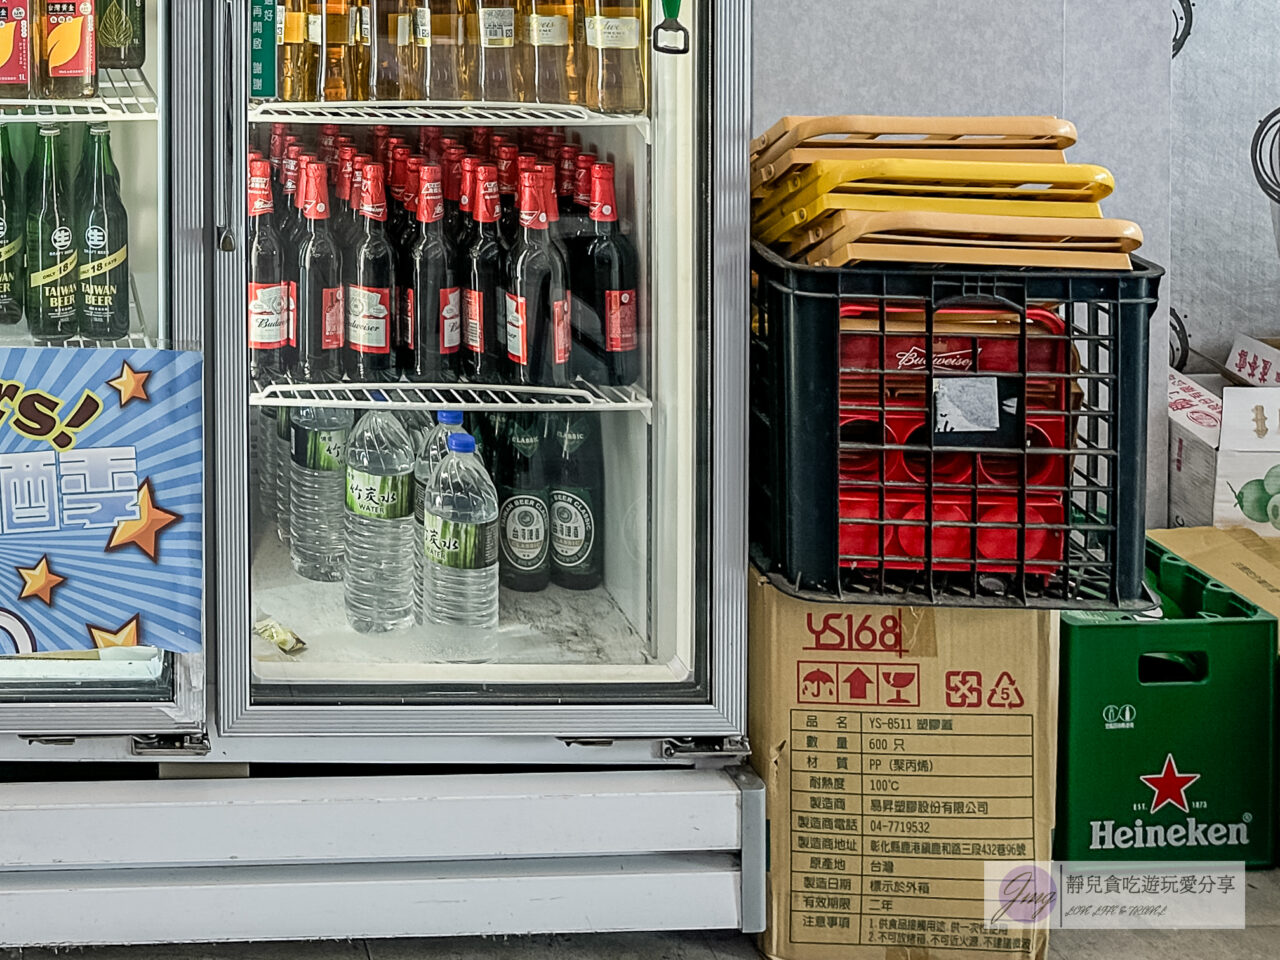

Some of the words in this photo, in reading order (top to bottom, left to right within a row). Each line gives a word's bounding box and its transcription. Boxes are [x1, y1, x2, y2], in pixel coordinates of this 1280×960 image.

[57, 263, 70, 275] 18
[44, 285, 78, 297] TAIWAN
[80, 283, 117, 295] TAIWAN
[49, 296, 76, 308] BEER
[84, 294, 114, 306] BEER
[896, 351, 973, 371] Buweiser
[349, 485, 397, 507] 竹炭水
[358, 502, 385, 515] WATER
[806, 612, 901, 651] YS168
[868, 738, 888, 751] 600
[893, 739, 905, 752] 只
[869, 758, 882, 771] PP
[870, 820, 931, 834] 04-7719532
[1089, 816, 1250, 851] Heineken
[870, 860, 895, 874] 台灣
[802, 895, 851, 911] 有效期限
[868, 898, 893, 912] 二年
